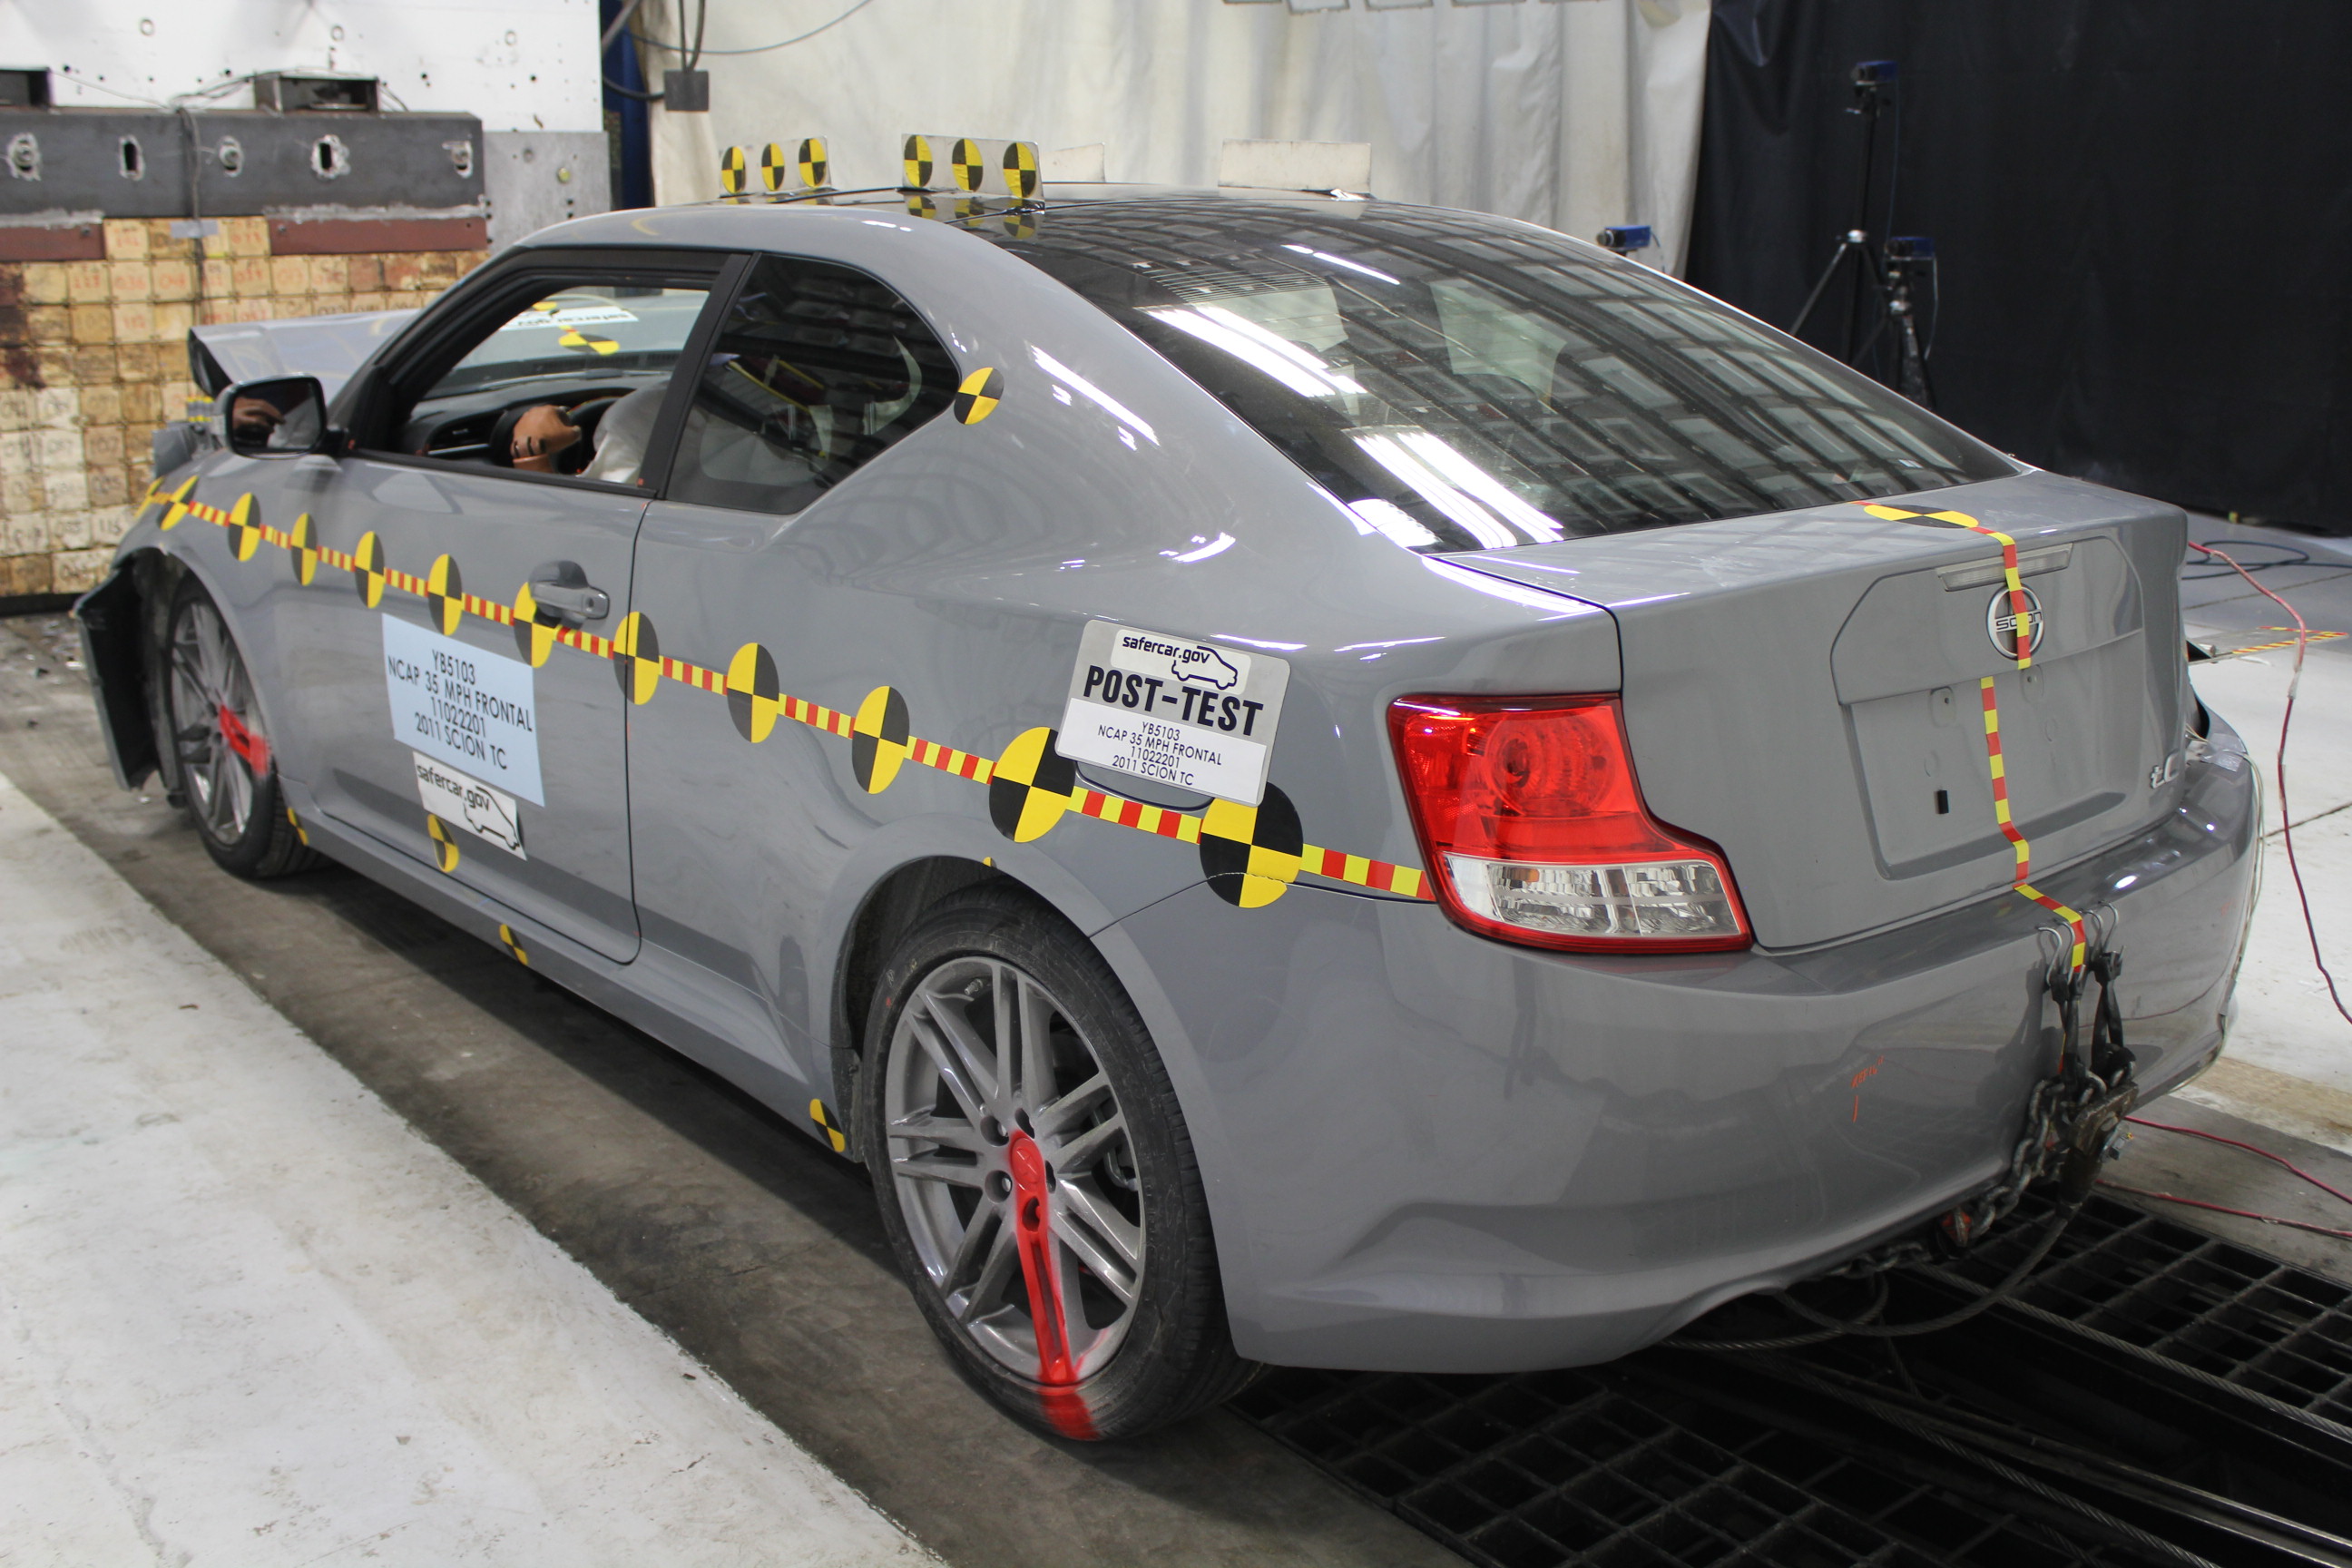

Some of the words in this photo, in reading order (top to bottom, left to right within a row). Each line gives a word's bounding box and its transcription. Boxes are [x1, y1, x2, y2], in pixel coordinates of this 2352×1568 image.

[432, 649, 475, 685] YB5103
[1122, 635, 1210, 664] safercar.gov
[387, 655, 420, 686] NCAP
[425, 671, 439, 694] 35
[445, 680, 471, 707] MPH
[475, 691, 533, 732] FRONTAL
[1083, 665, 1264, 737] POST-TEST
[430, 696, 486, 738] 11022201
[1142, 721, 1181, 741] YB5103
[415, 712, 441, 740] 2011
[446, 729, 485, 761] SCION
[490, 744, 507, 770] TC
[1097, 724, 1128, 742] NCAP
[1129, 732, 1142, 747] 35
[1144, 736, 1171, 753] MPH
[1172, 742, 1222, 767] FRONTAL
[1131, 746, 1181, 769] 11022201
[416, 764, 490, 812] safercar.gov
[1112, 755, 1137, 771] 2011
[1141, 761, 1177, 781] SCION
[1180, 771, 1195, 786] TC
